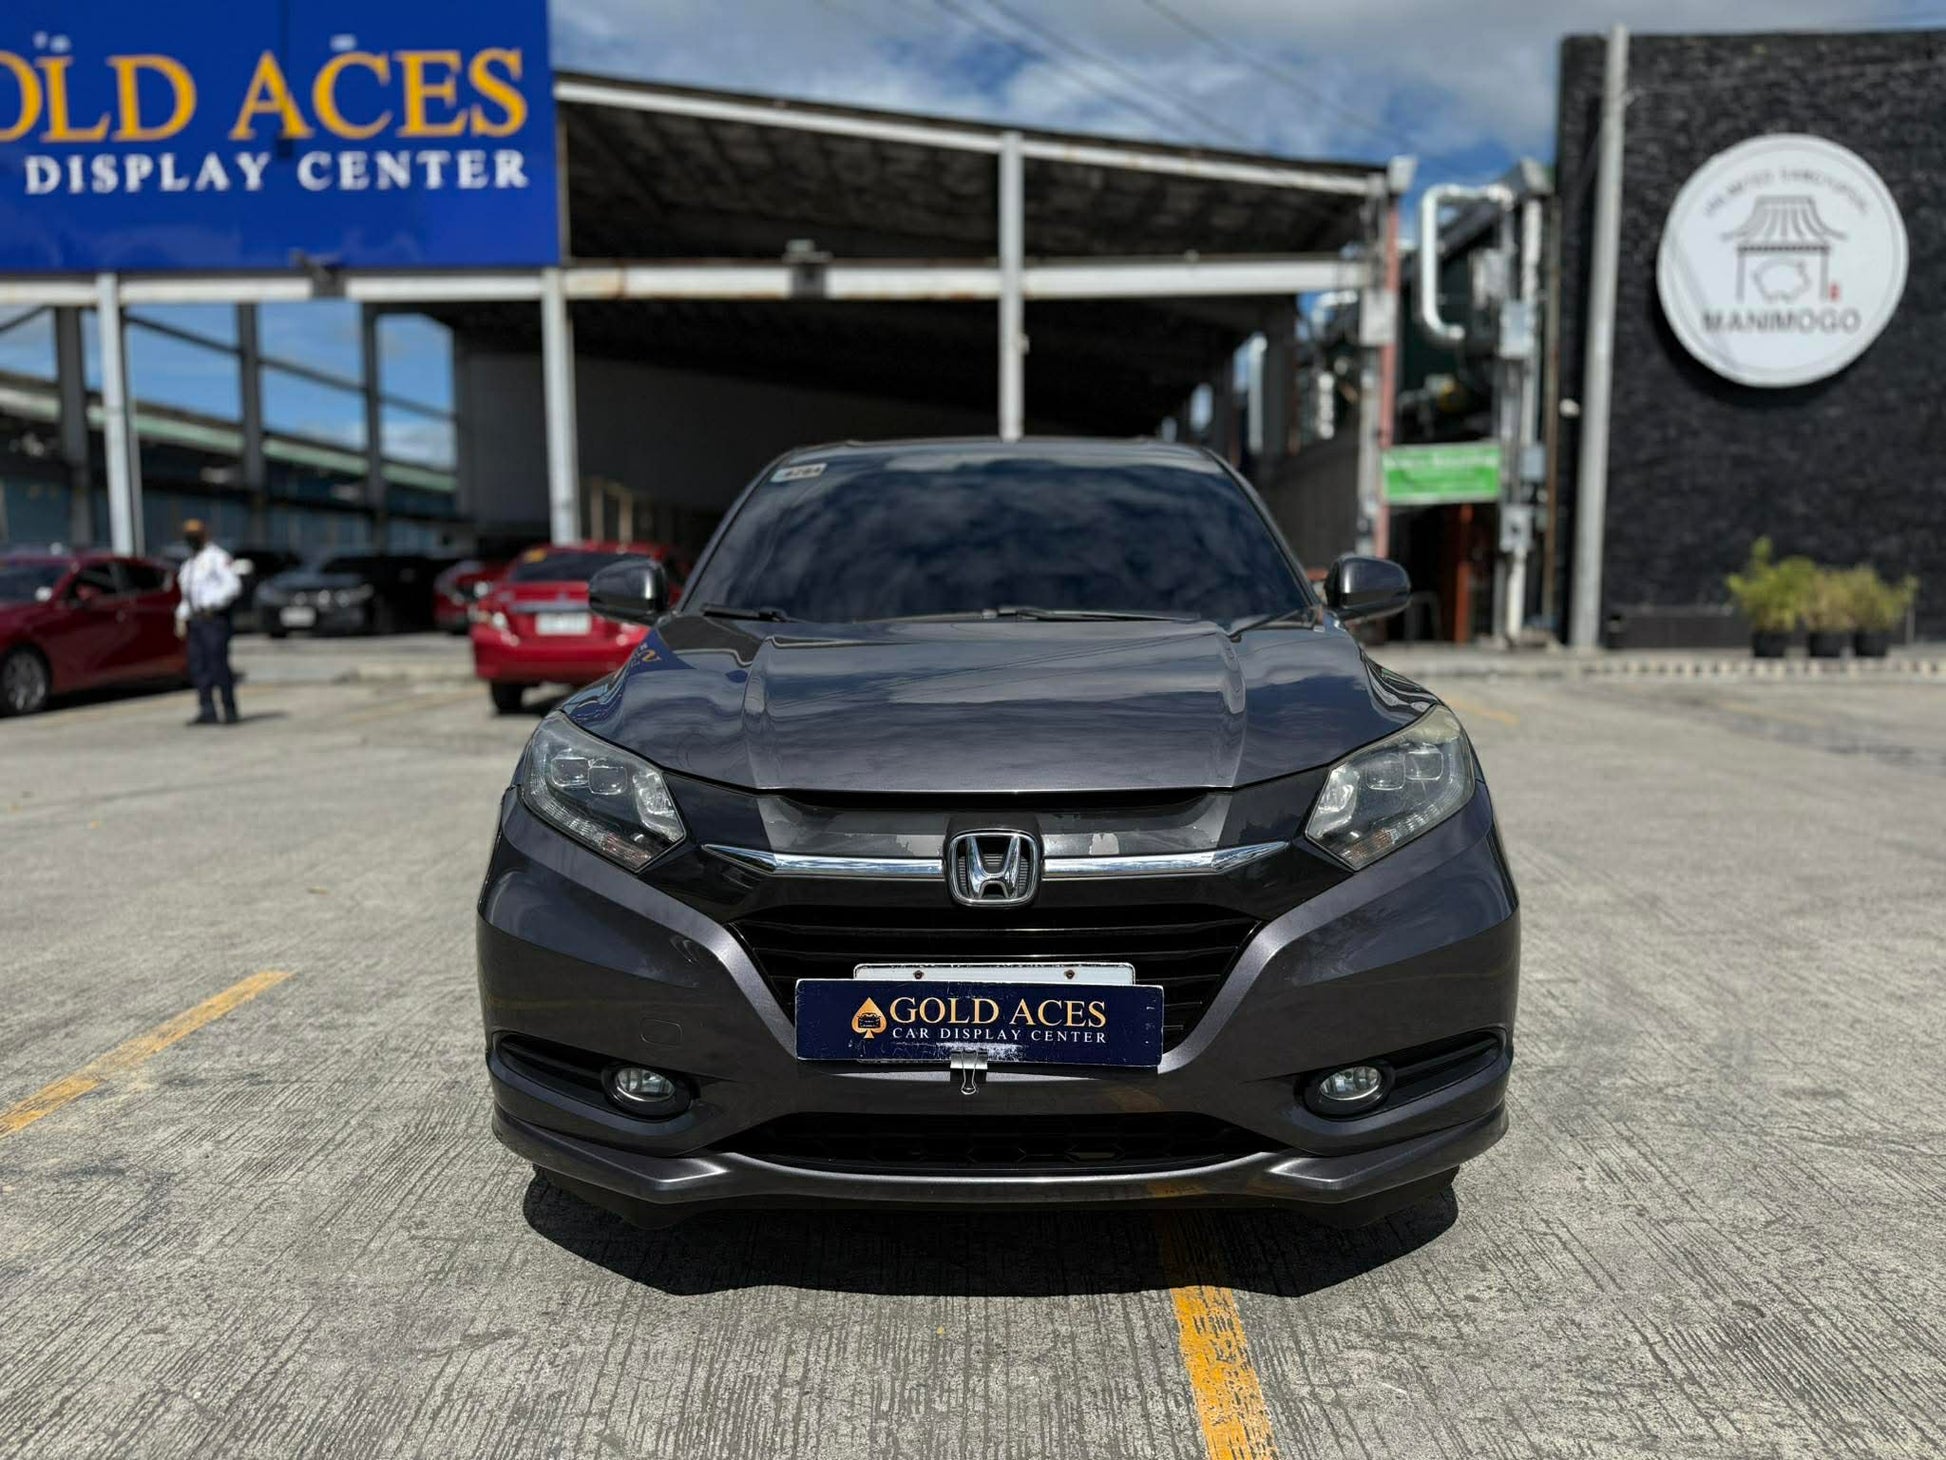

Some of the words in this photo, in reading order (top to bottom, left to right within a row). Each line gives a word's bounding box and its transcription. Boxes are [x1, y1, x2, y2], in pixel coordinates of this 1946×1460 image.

[229, 48, 528, 141] ACES
[24, 153, 270, 194] DISPLAY
[297, 149, 529, 190] CENTER
[1702, 307, 1862, 334] MANIMOGO
[889, 997, 999, 1025] GOLD
[1010, 999, 1107, 1028] ACES
[892, 1027, 930, 1039] CAR
[940, 1027, 1021, 1041] DISPLAY
[1030, 1029, 1107, 1044] CENTER
